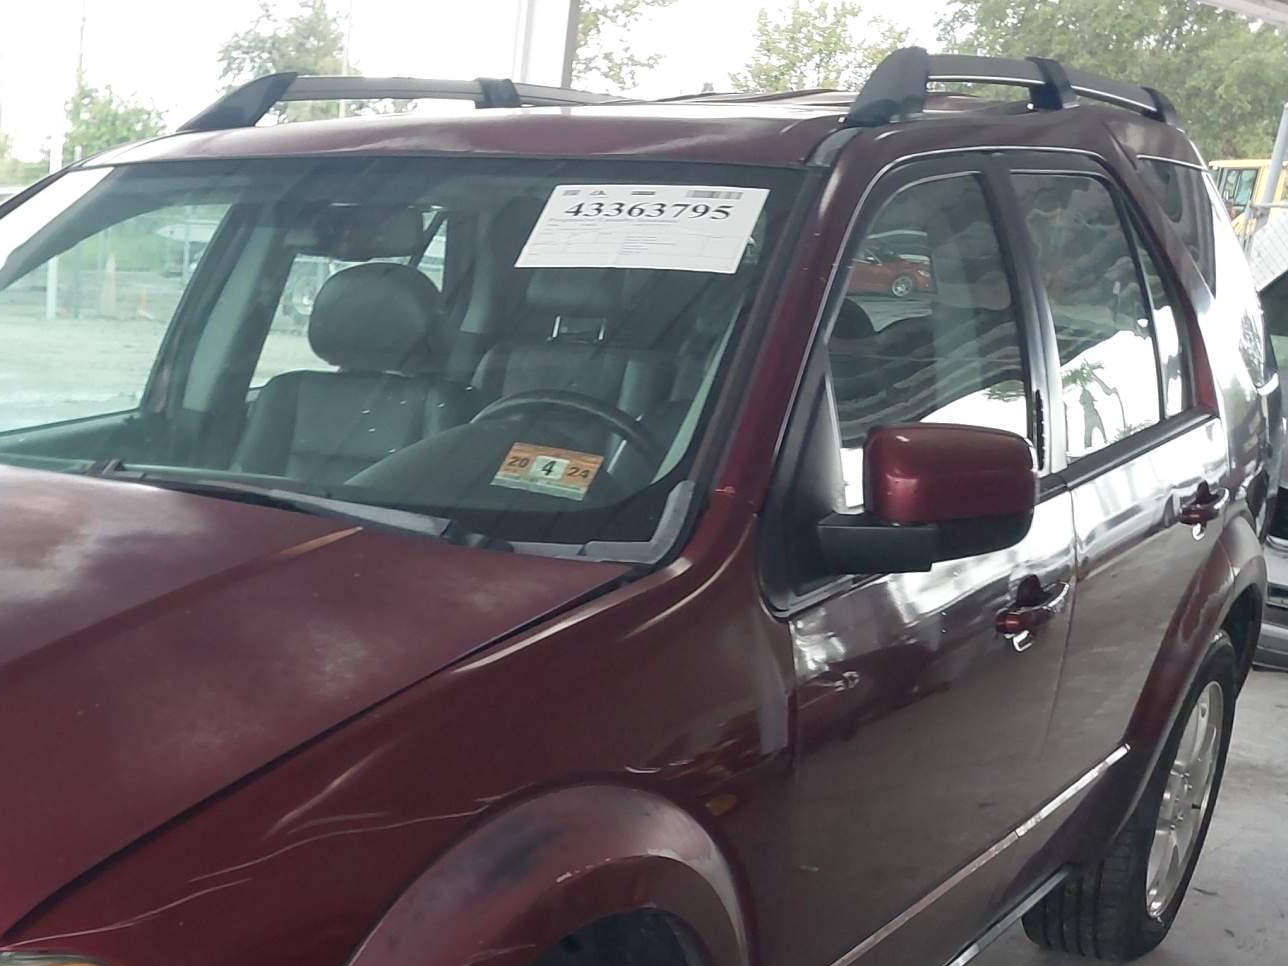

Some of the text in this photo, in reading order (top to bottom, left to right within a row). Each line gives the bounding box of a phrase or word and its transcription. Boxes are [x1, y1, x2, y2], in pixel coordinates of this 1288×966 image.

[564, 202, 734, 220] 43363795
[506, 456, 530, 469] 20
[541, 460, 556, 476] 4
